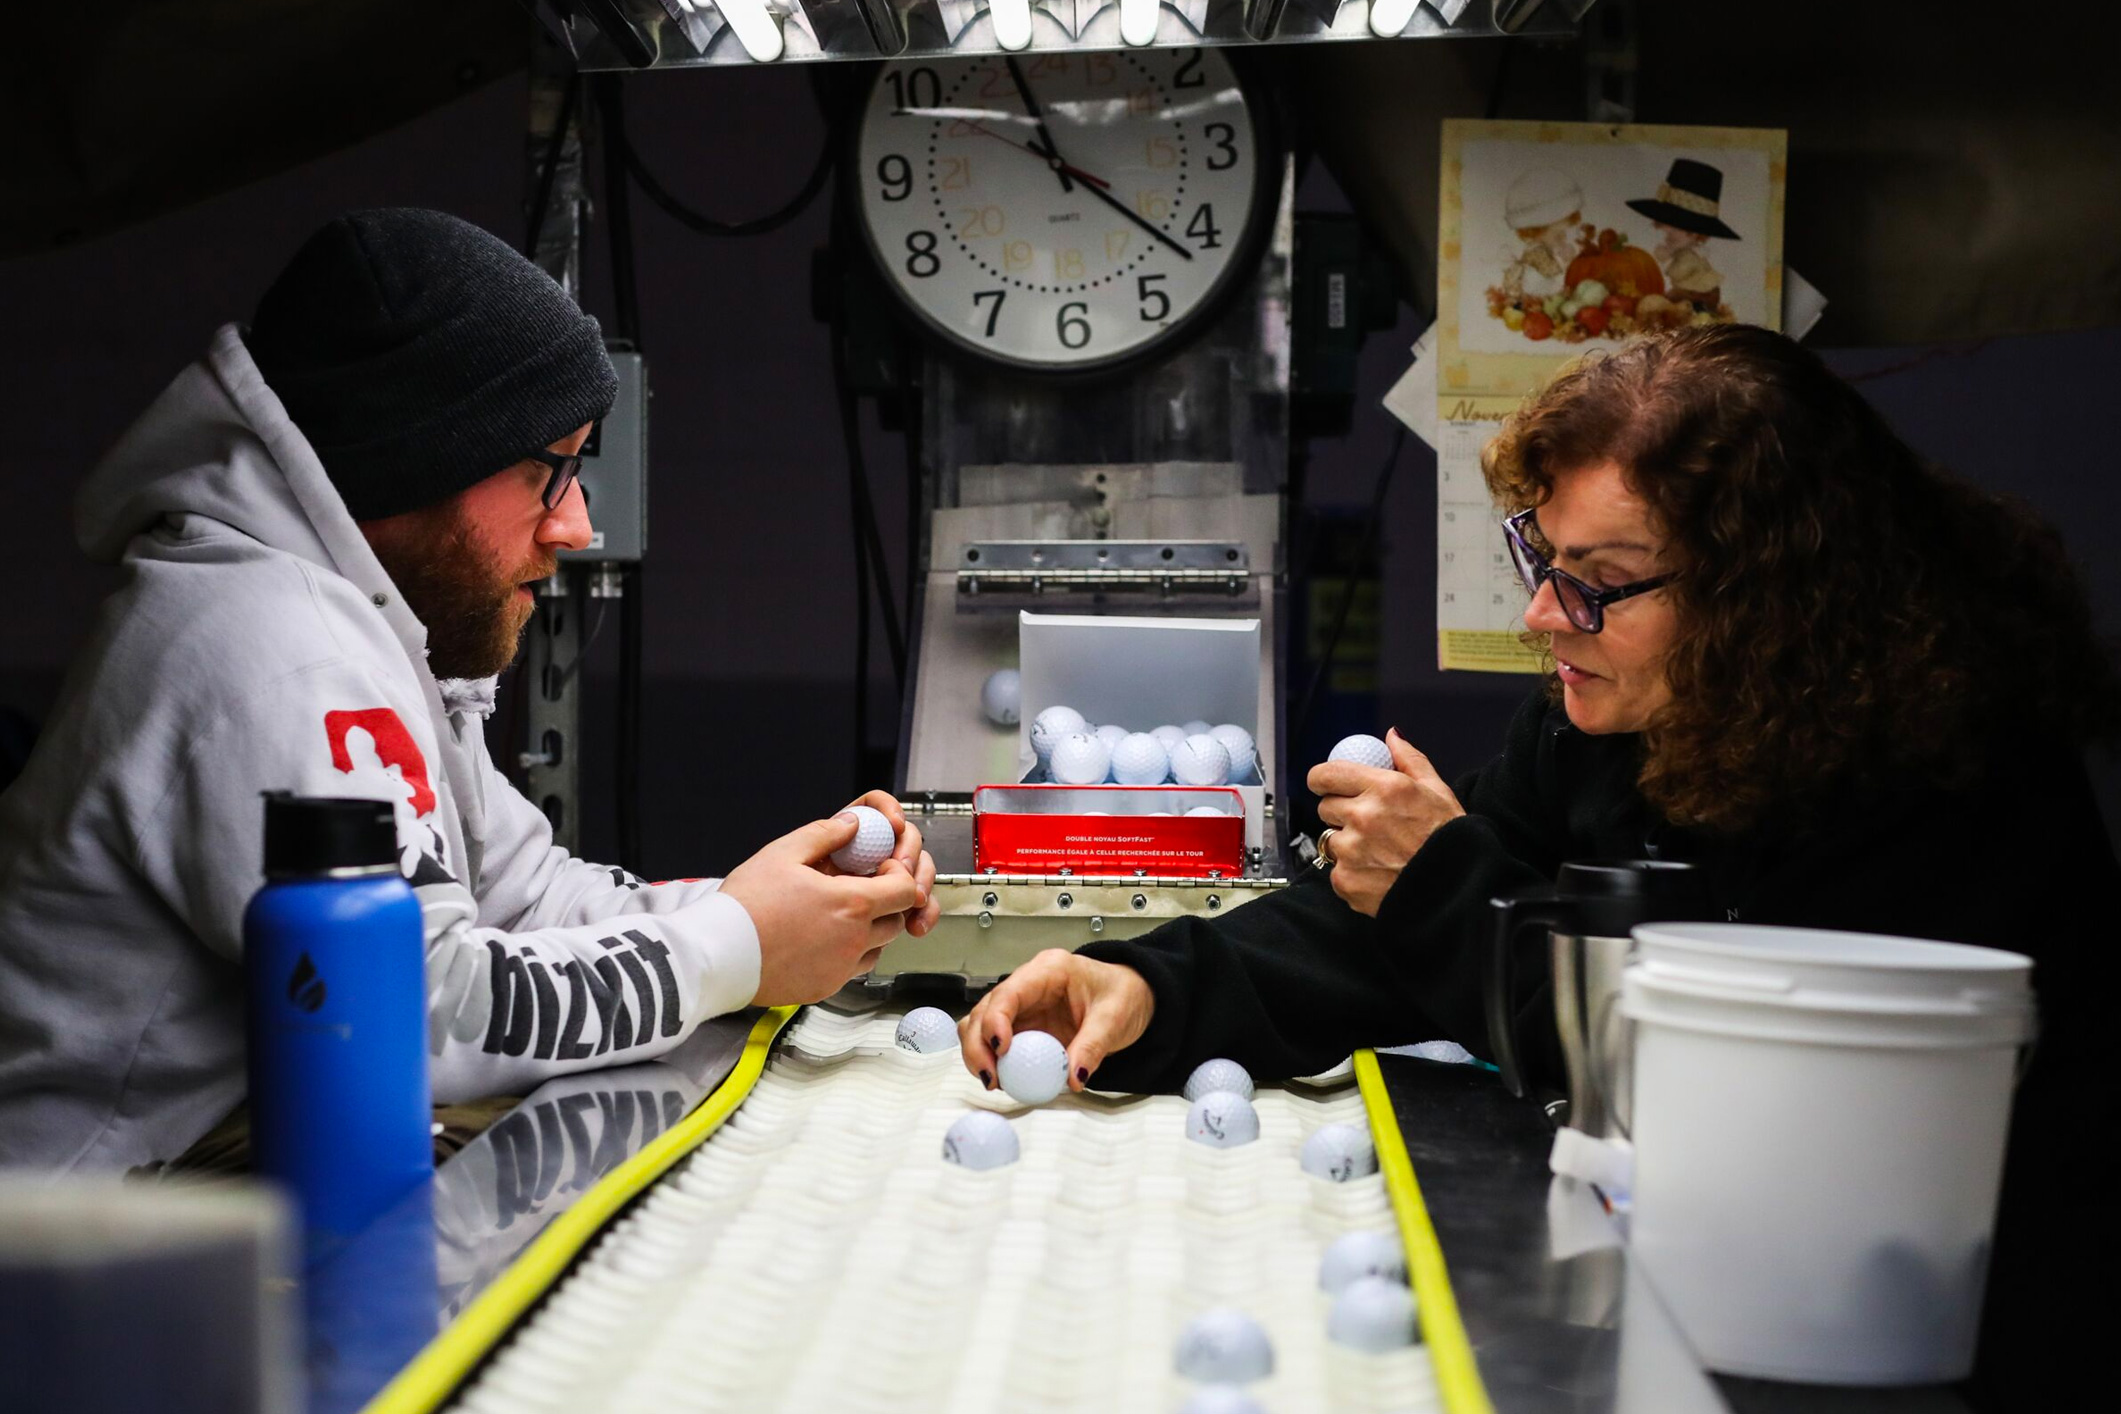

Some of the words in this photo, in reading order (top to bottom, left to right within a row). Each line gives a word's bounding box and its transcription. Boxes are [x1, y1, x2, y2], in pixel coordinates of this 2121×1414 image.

[885, 67, 942, 117] 10
[1172, 48, 1206, 88] 2
[1204, 122, 1238, 171] 3
[877, 153, 914, 202] 9
[960, 204, 1005, 239] 20
[1185, 202, 1223, 250] 4
[905, 230, 941, 278] 8
[1003, 238, 1033, 272] 19
[1054, 248, 1086, 281] 18
[973, 290, 1007, 338] 7
[1137, 273, 1171, 322] 5
[1055, 302, 1092, 349] 6
